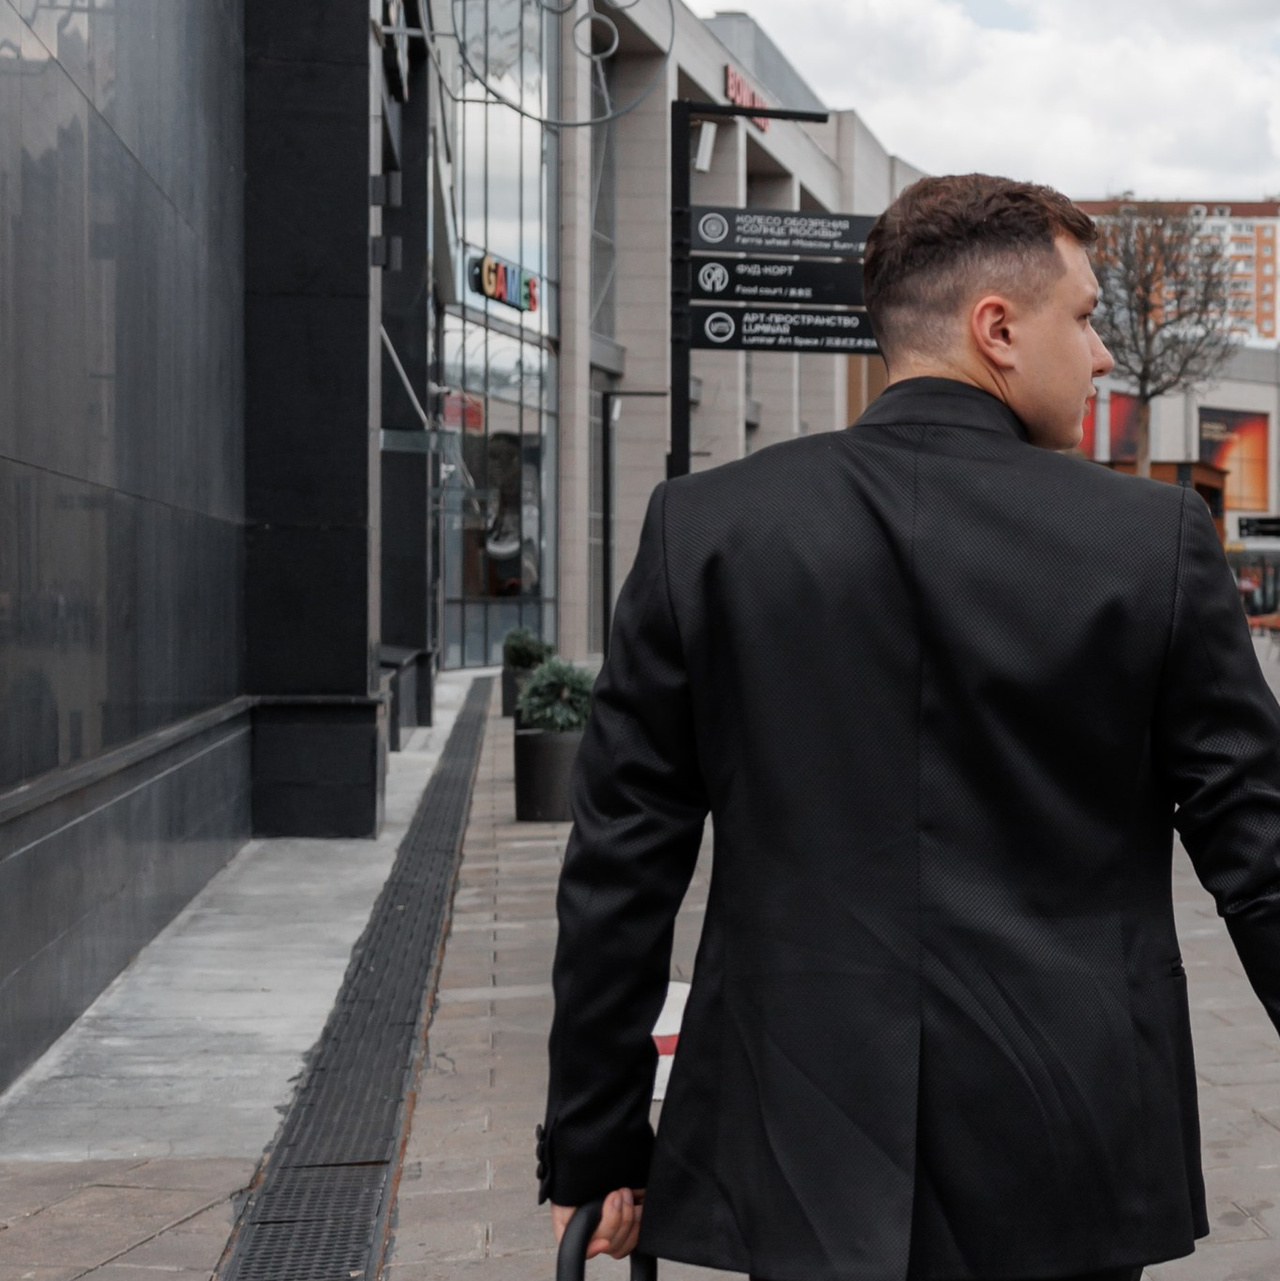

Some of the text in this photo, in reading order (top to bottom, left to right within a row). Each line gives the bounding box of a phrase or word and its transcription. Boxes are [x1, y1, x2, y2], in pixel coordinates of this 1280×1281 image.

[735, 214, 781, 226] КОЛЕСО
[481, 254, 539, 312] GAMES
[742, 322, 790, 335] LUMINAR
